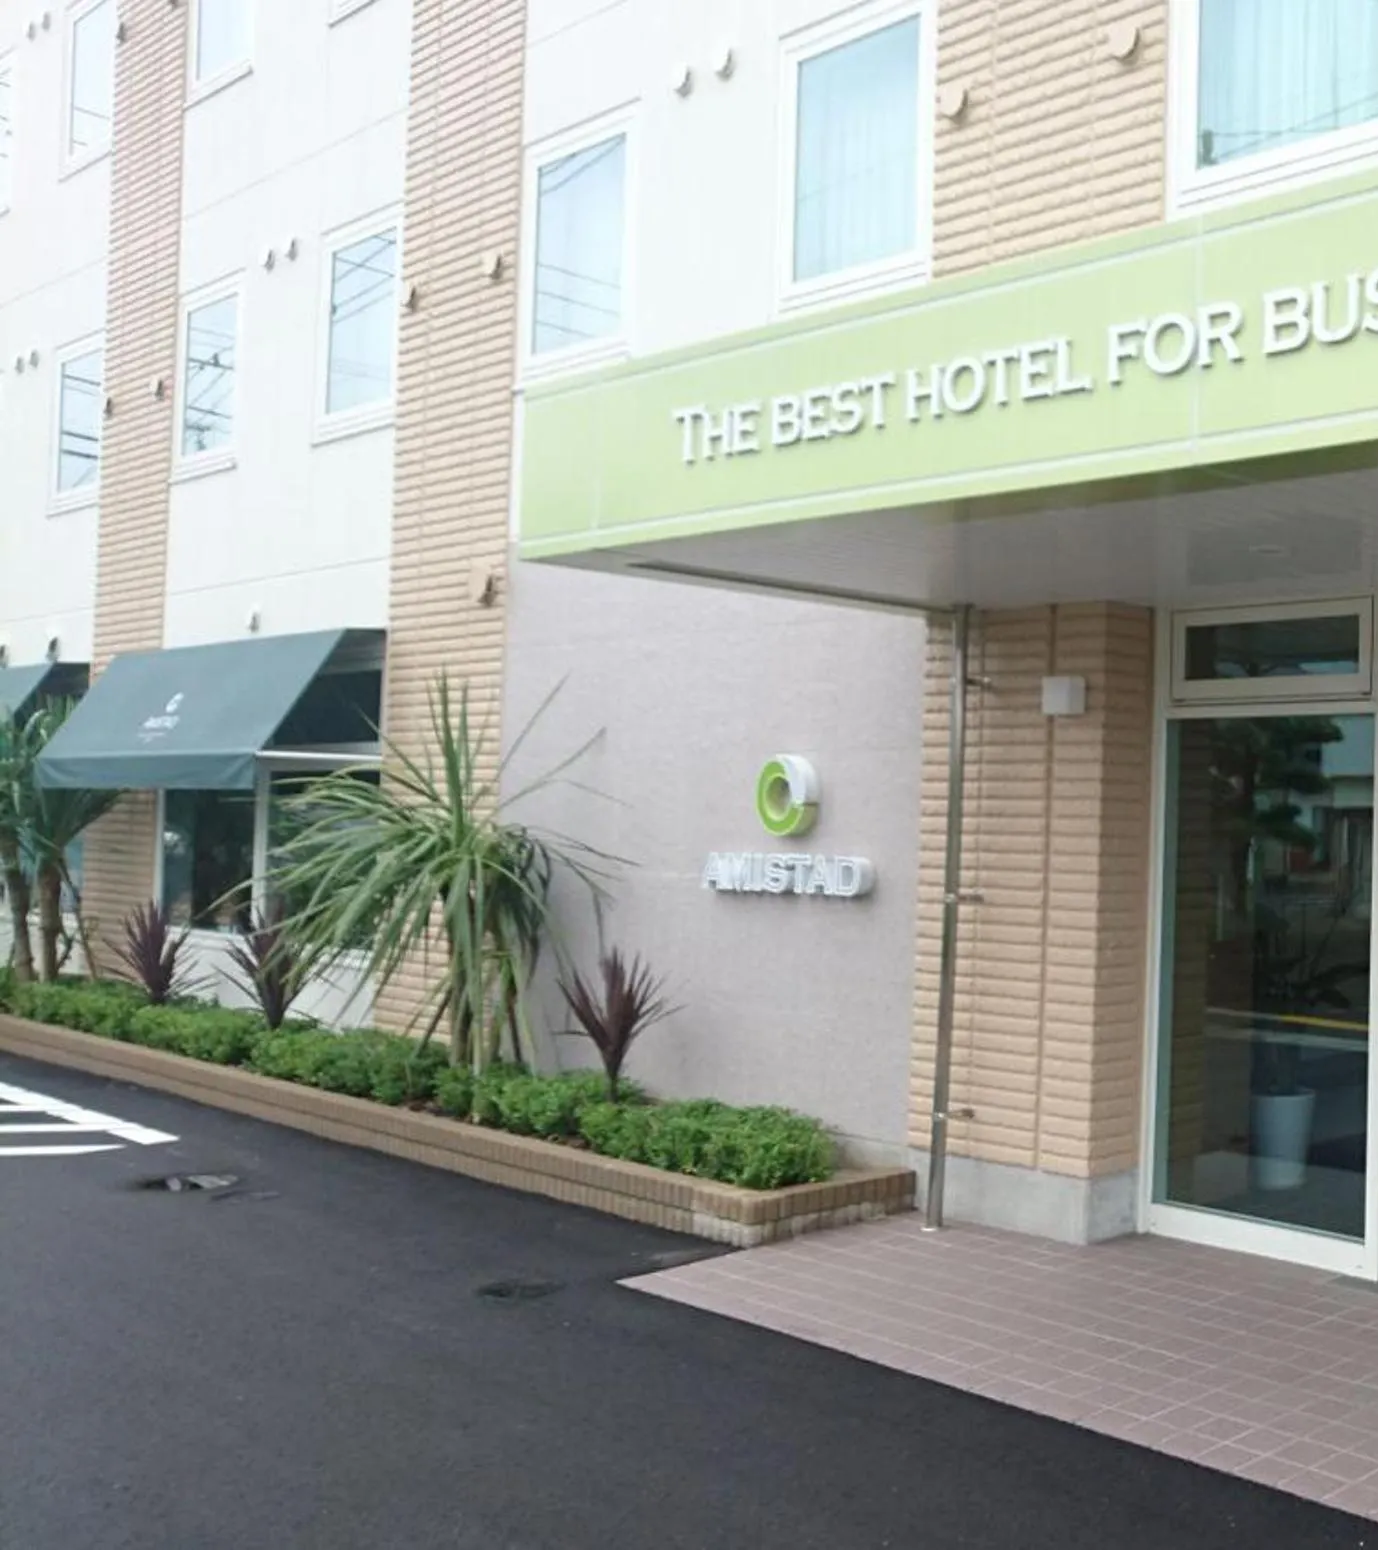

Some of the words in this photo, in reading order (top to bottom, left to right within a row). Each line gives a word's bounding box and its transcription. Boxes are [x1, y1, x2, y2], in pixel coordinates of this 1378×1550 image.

[673, 403, 761, 465] THE
[769, 371, 895, 447] BEST
[905, 336, 1094, 423] HOTEL
[1107, 301, 1245, 386] FOR
[702, 852, 873, 897] AMISTAD
